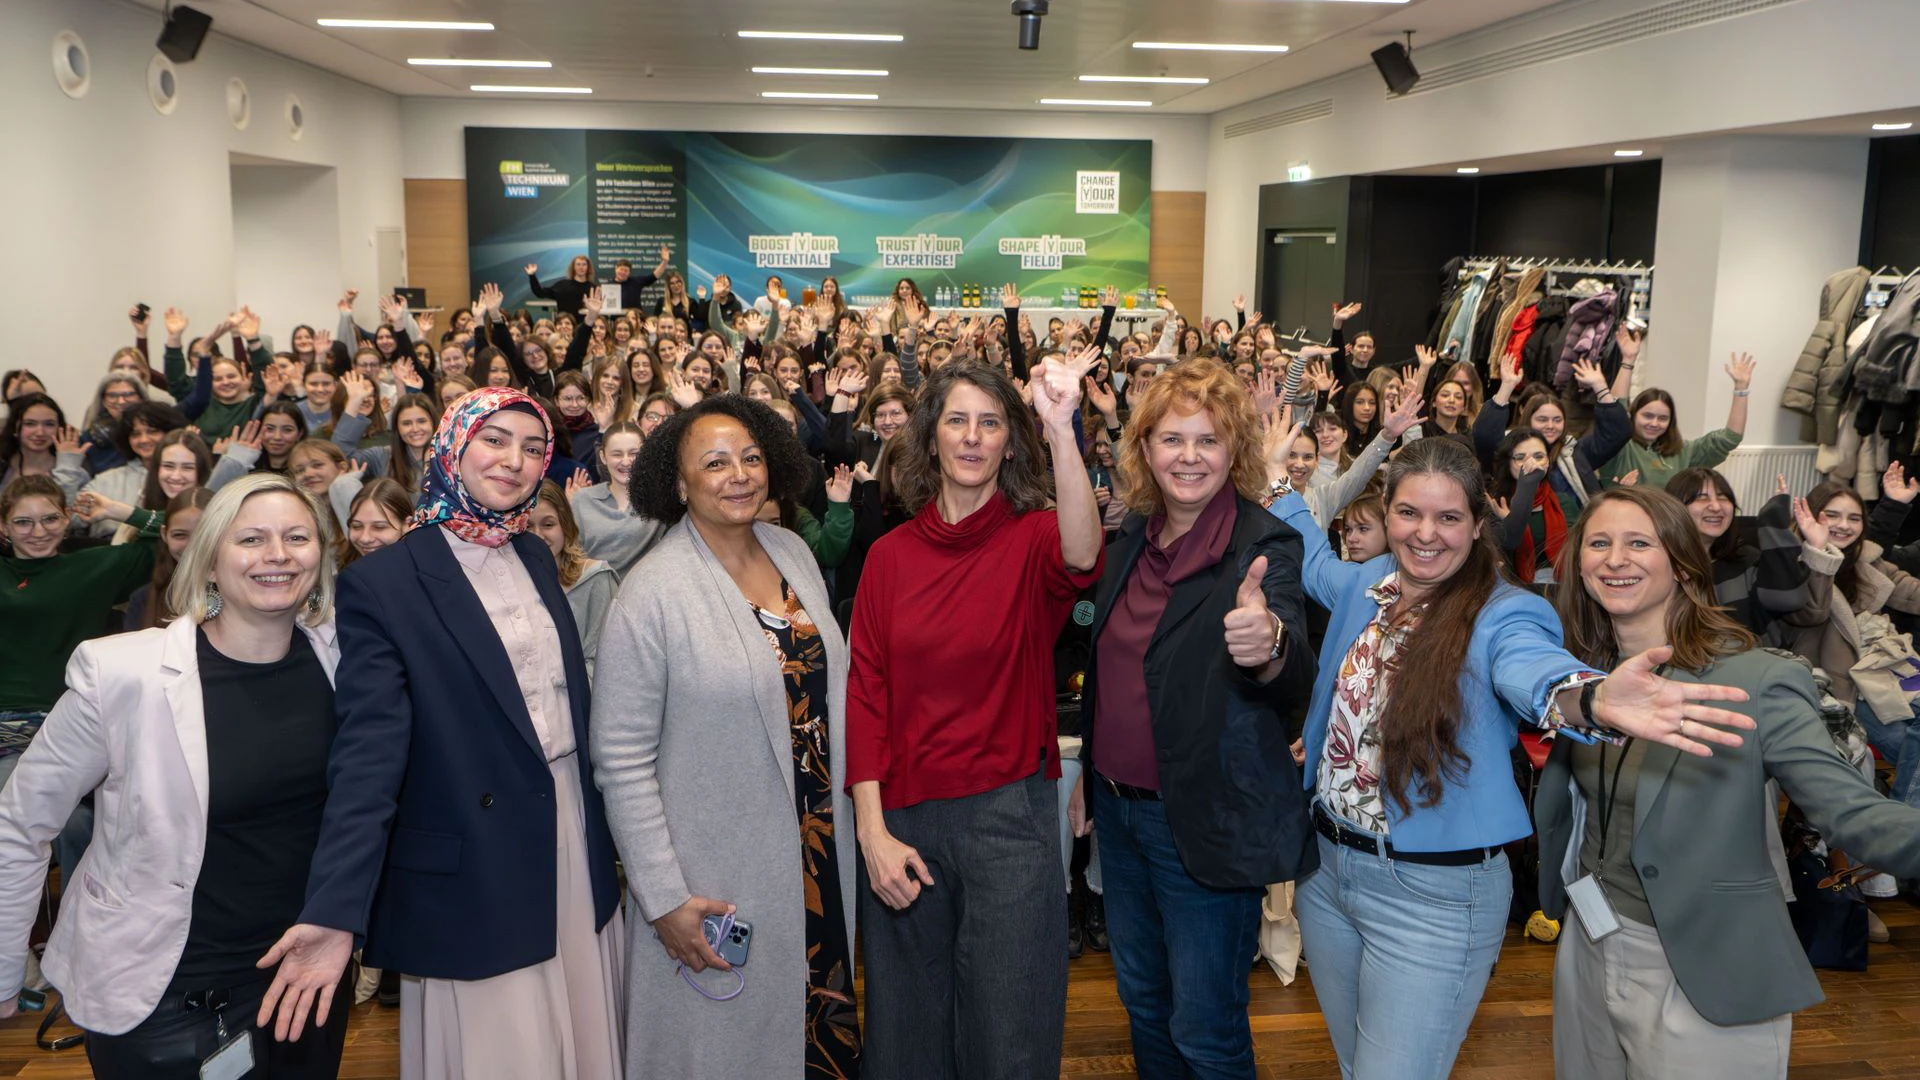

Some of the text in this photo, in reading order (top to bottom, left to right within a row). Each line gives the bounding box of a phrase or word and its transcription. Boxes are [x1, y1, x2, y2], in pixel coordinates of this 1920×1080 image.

[507, 175, 567, 185] TECHNIKUM
[1080, 176, 1115, 186] CHANGE
[507, 186, 535, 196] WIEN
[751, 238, 790, 250] BOOST
[878, 239, 916, 252] TRUST
[1000, 240, 1040, 252] SHAPE
[759, 253, 828, 266] POTENTIAL!
[885, 254, 954, 266] EXPERTISE!
[1024, 255, 1060, 267] FIELD!
